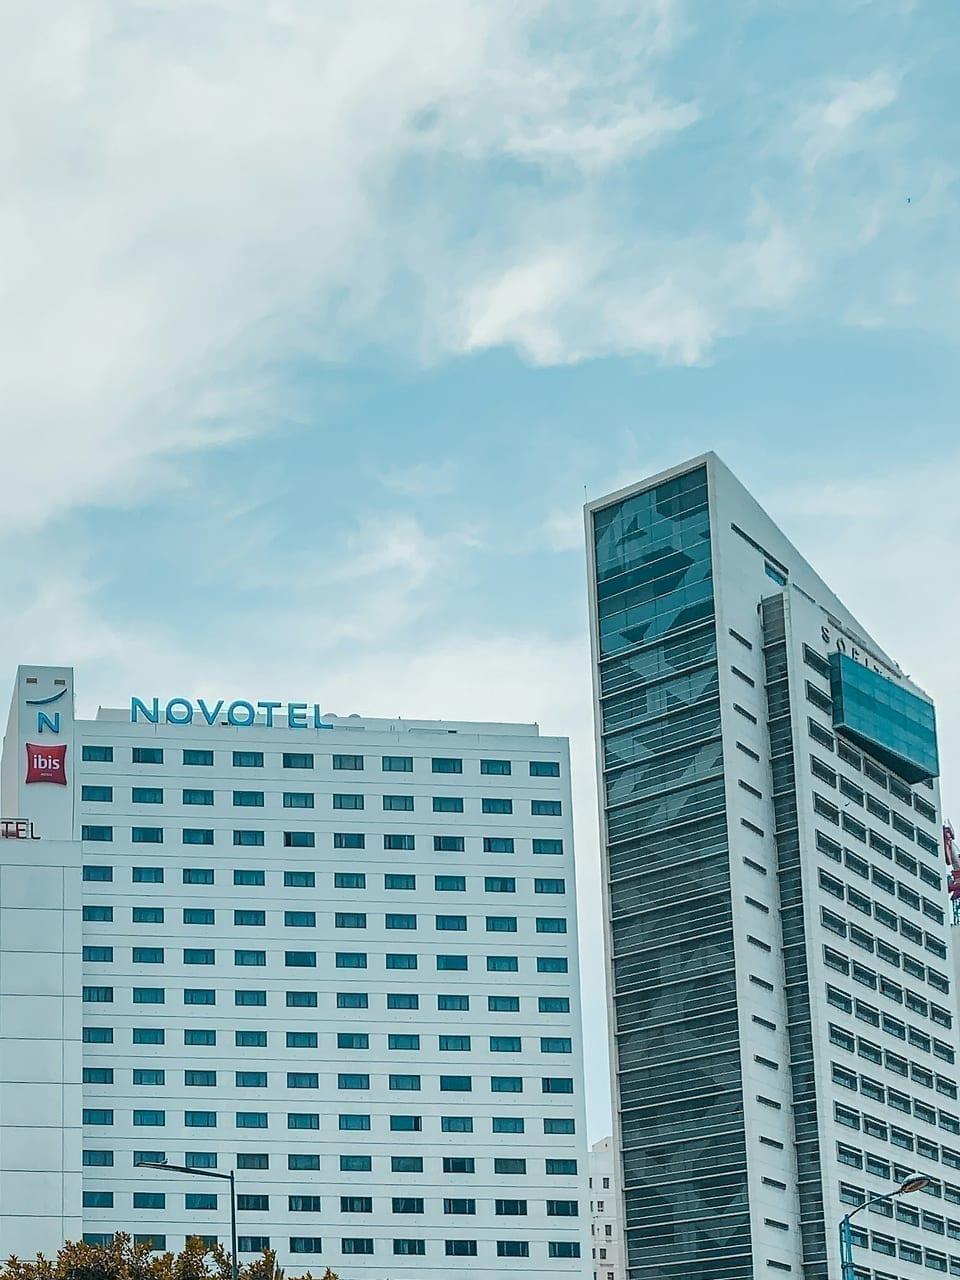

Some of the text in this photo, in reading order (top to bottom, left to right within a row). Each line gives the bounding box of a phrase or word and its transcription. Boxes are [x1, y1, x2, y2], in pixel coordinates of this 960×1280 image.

[38, 711, 60, 733] N
[131, 696, 334, 730] NOVOTEL
[33, 754, 60, 770] ibis
